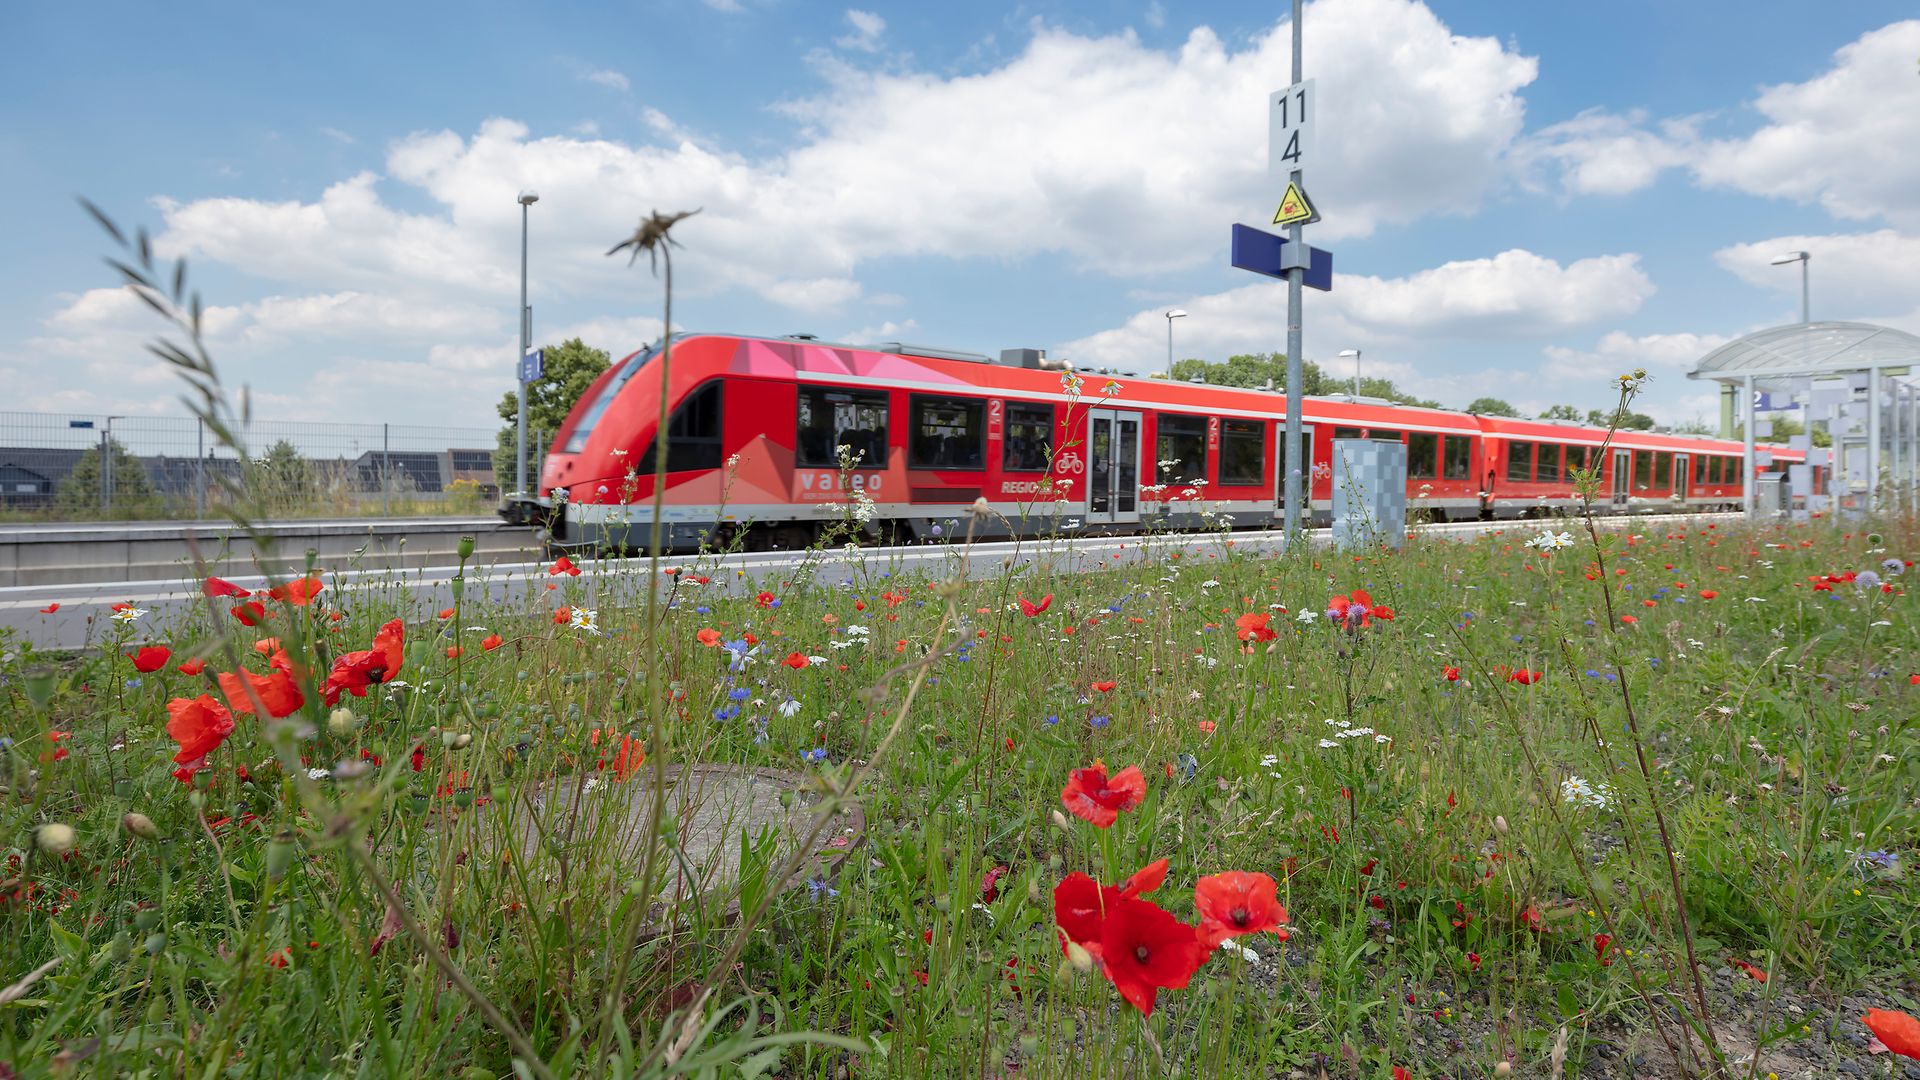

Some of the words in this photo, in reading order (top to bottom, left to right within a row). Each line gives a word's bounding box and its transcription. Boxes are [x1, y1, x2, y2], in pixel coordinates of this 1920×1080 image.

[1279, 88, 1305, 129] 11
[1281, 129, 1302, 163] 4
[1753, 390, 1762, 408] 2
[991, 400, 1001, 416] 2
[1210, 417, 1218, 431] 2
[1001, 481, 1037, 494] REGIO
